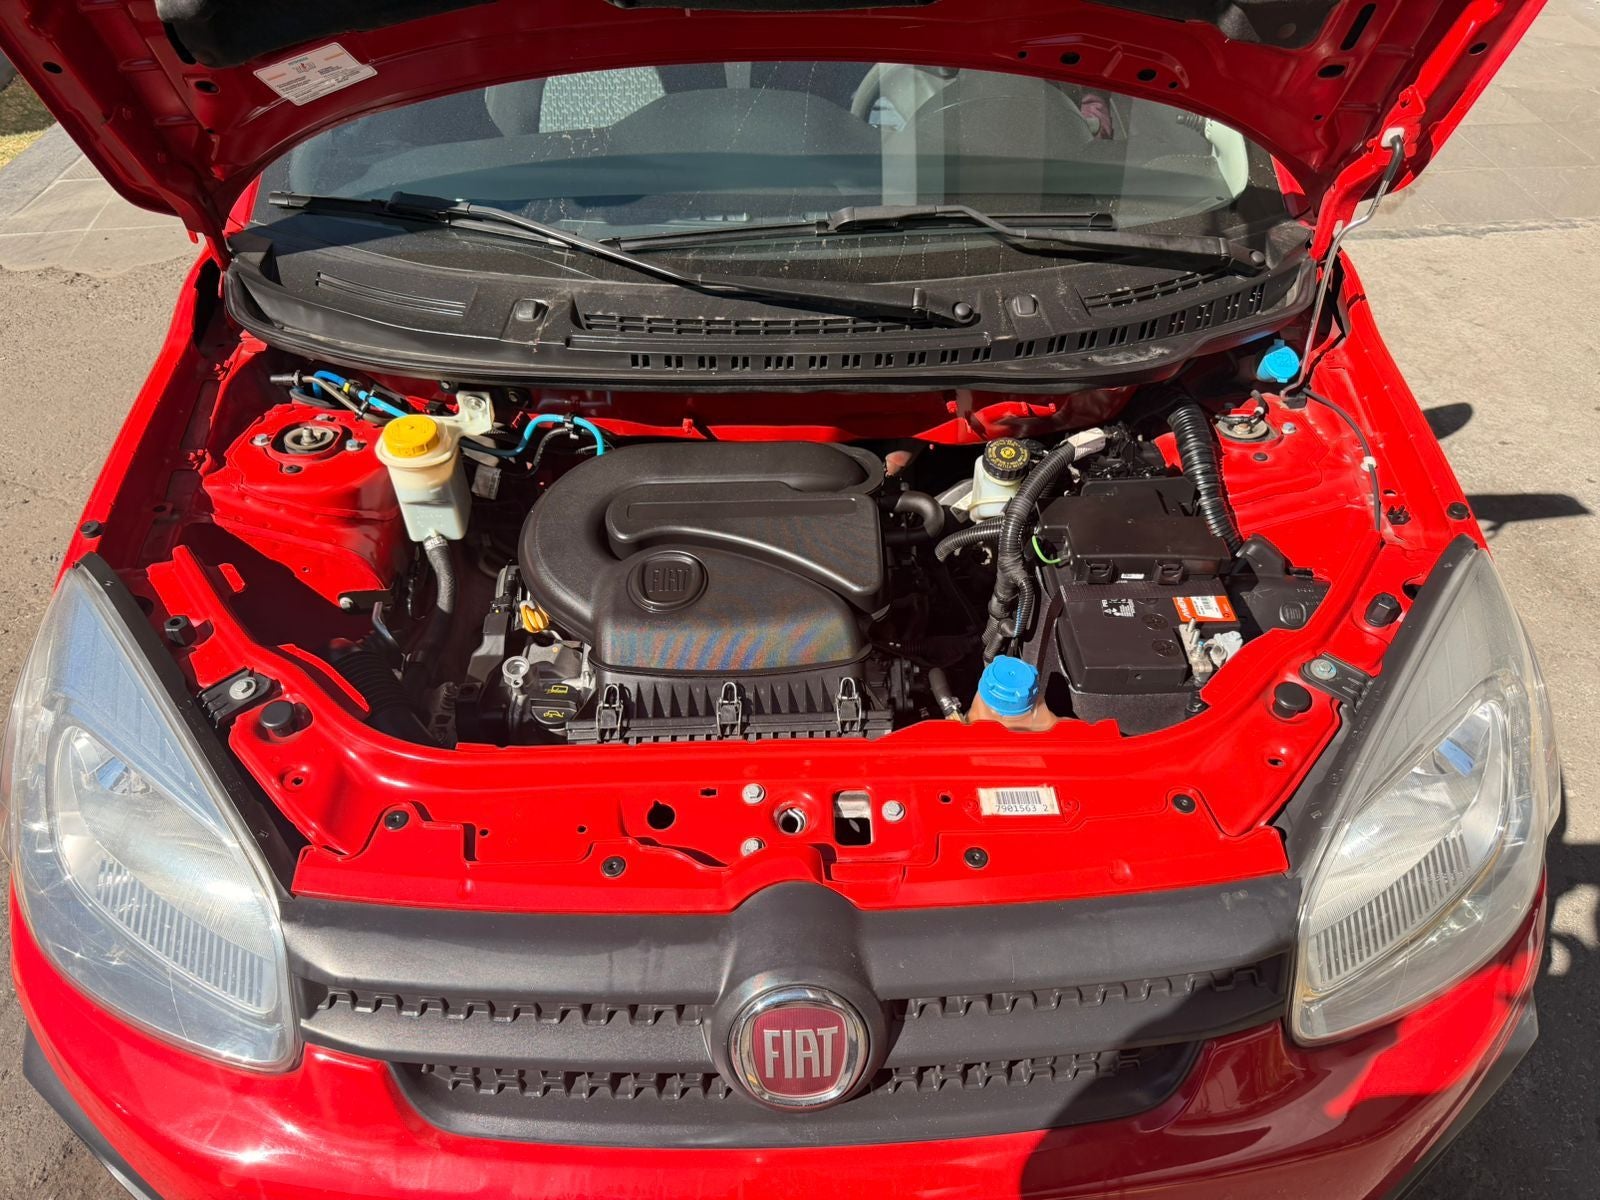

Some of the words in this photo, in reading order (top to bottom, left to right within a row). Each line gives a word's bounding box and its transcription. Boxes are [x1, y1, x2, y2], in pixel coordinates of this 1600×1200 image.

[648, 568, 689, 592] FIAT
[1042, 804, 1048, 812] 2
[763, 1026, 838, 1079] FIAT
